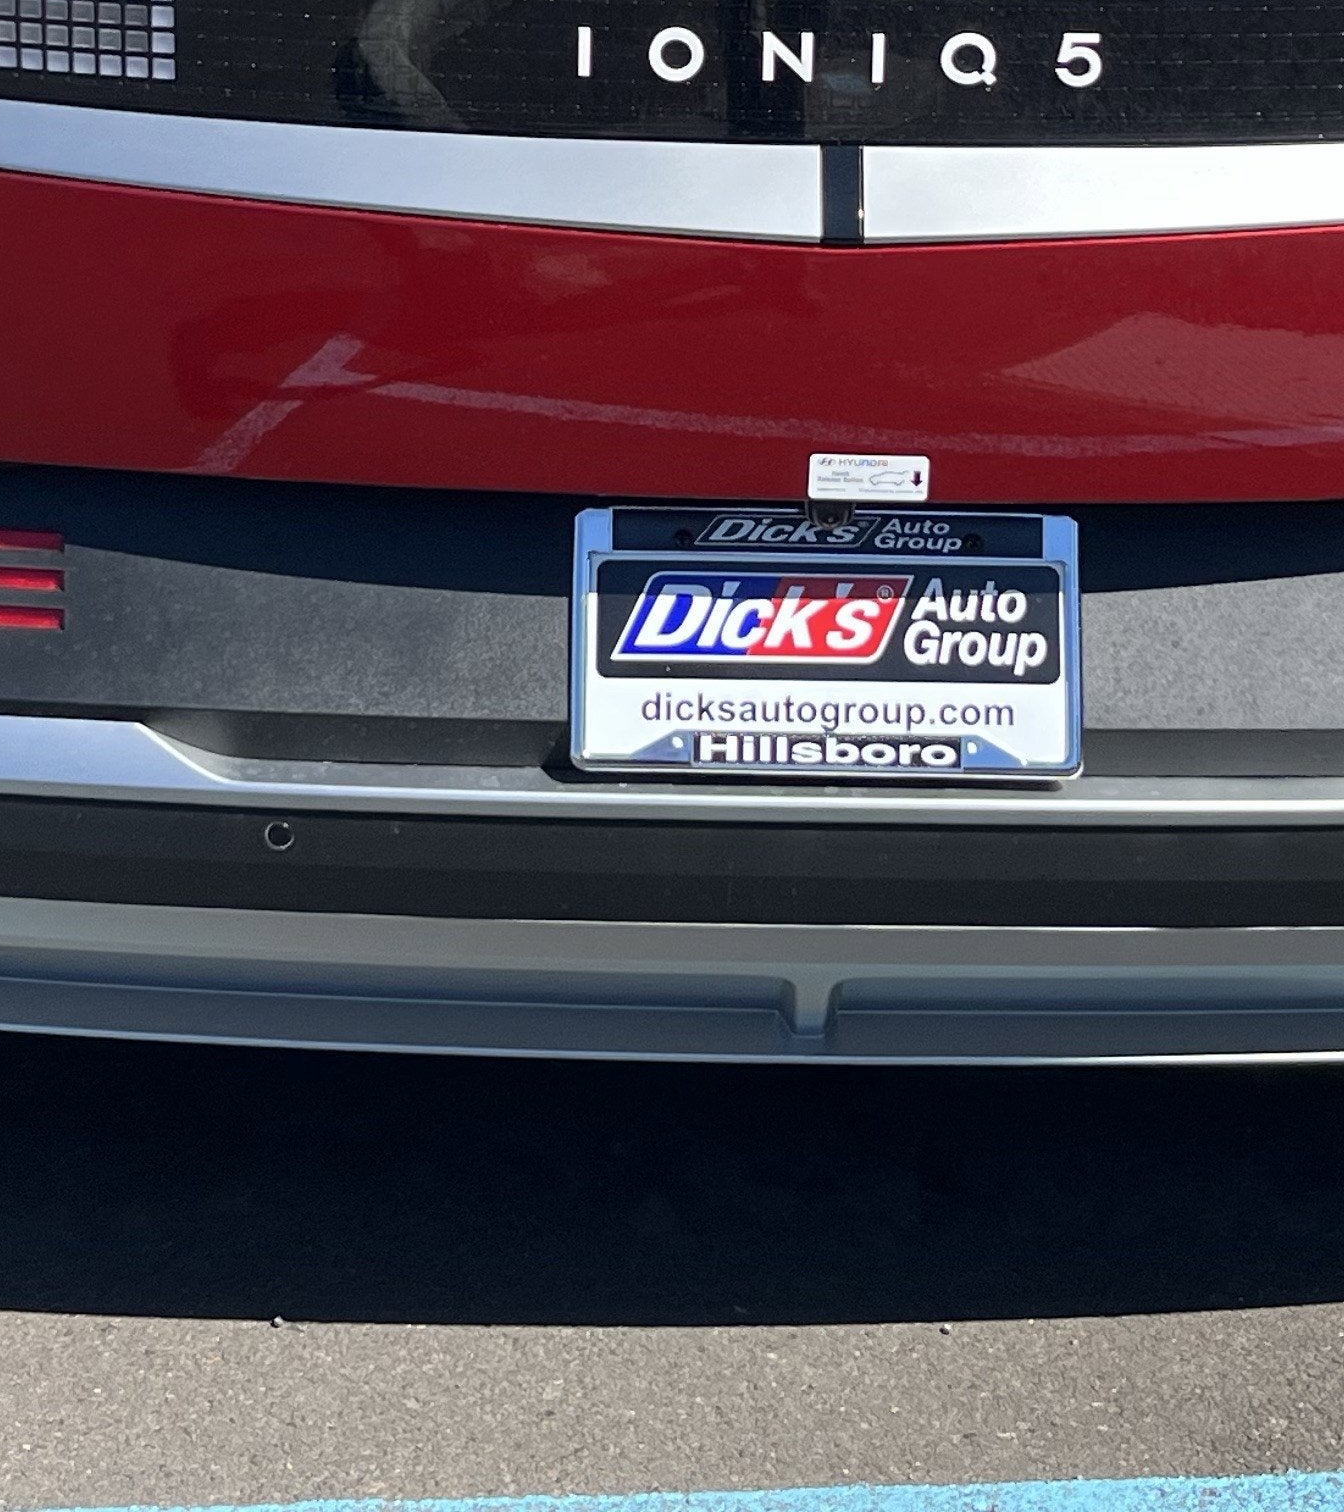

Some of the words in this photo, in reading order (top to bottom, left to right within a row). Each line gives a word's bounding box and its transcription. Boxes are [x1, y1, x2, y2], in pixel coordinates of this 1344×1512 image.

[577, 26, 997, 86] IONIQ
[1055, 32, 1102, 87] 5
[708, 518, 860, 543] Dicks
[874, 533, 962, 553] Group
[881, 518, 951, 535] Auto
[633, 581, 882, 652] Dick's
[911, 578, 1028, 625] Auto
[903, 620, 1048, 676] Group
[640, 692, 1015, 732] dicksautogroup.com
[698, 735, 957, 767] Hillsboro
